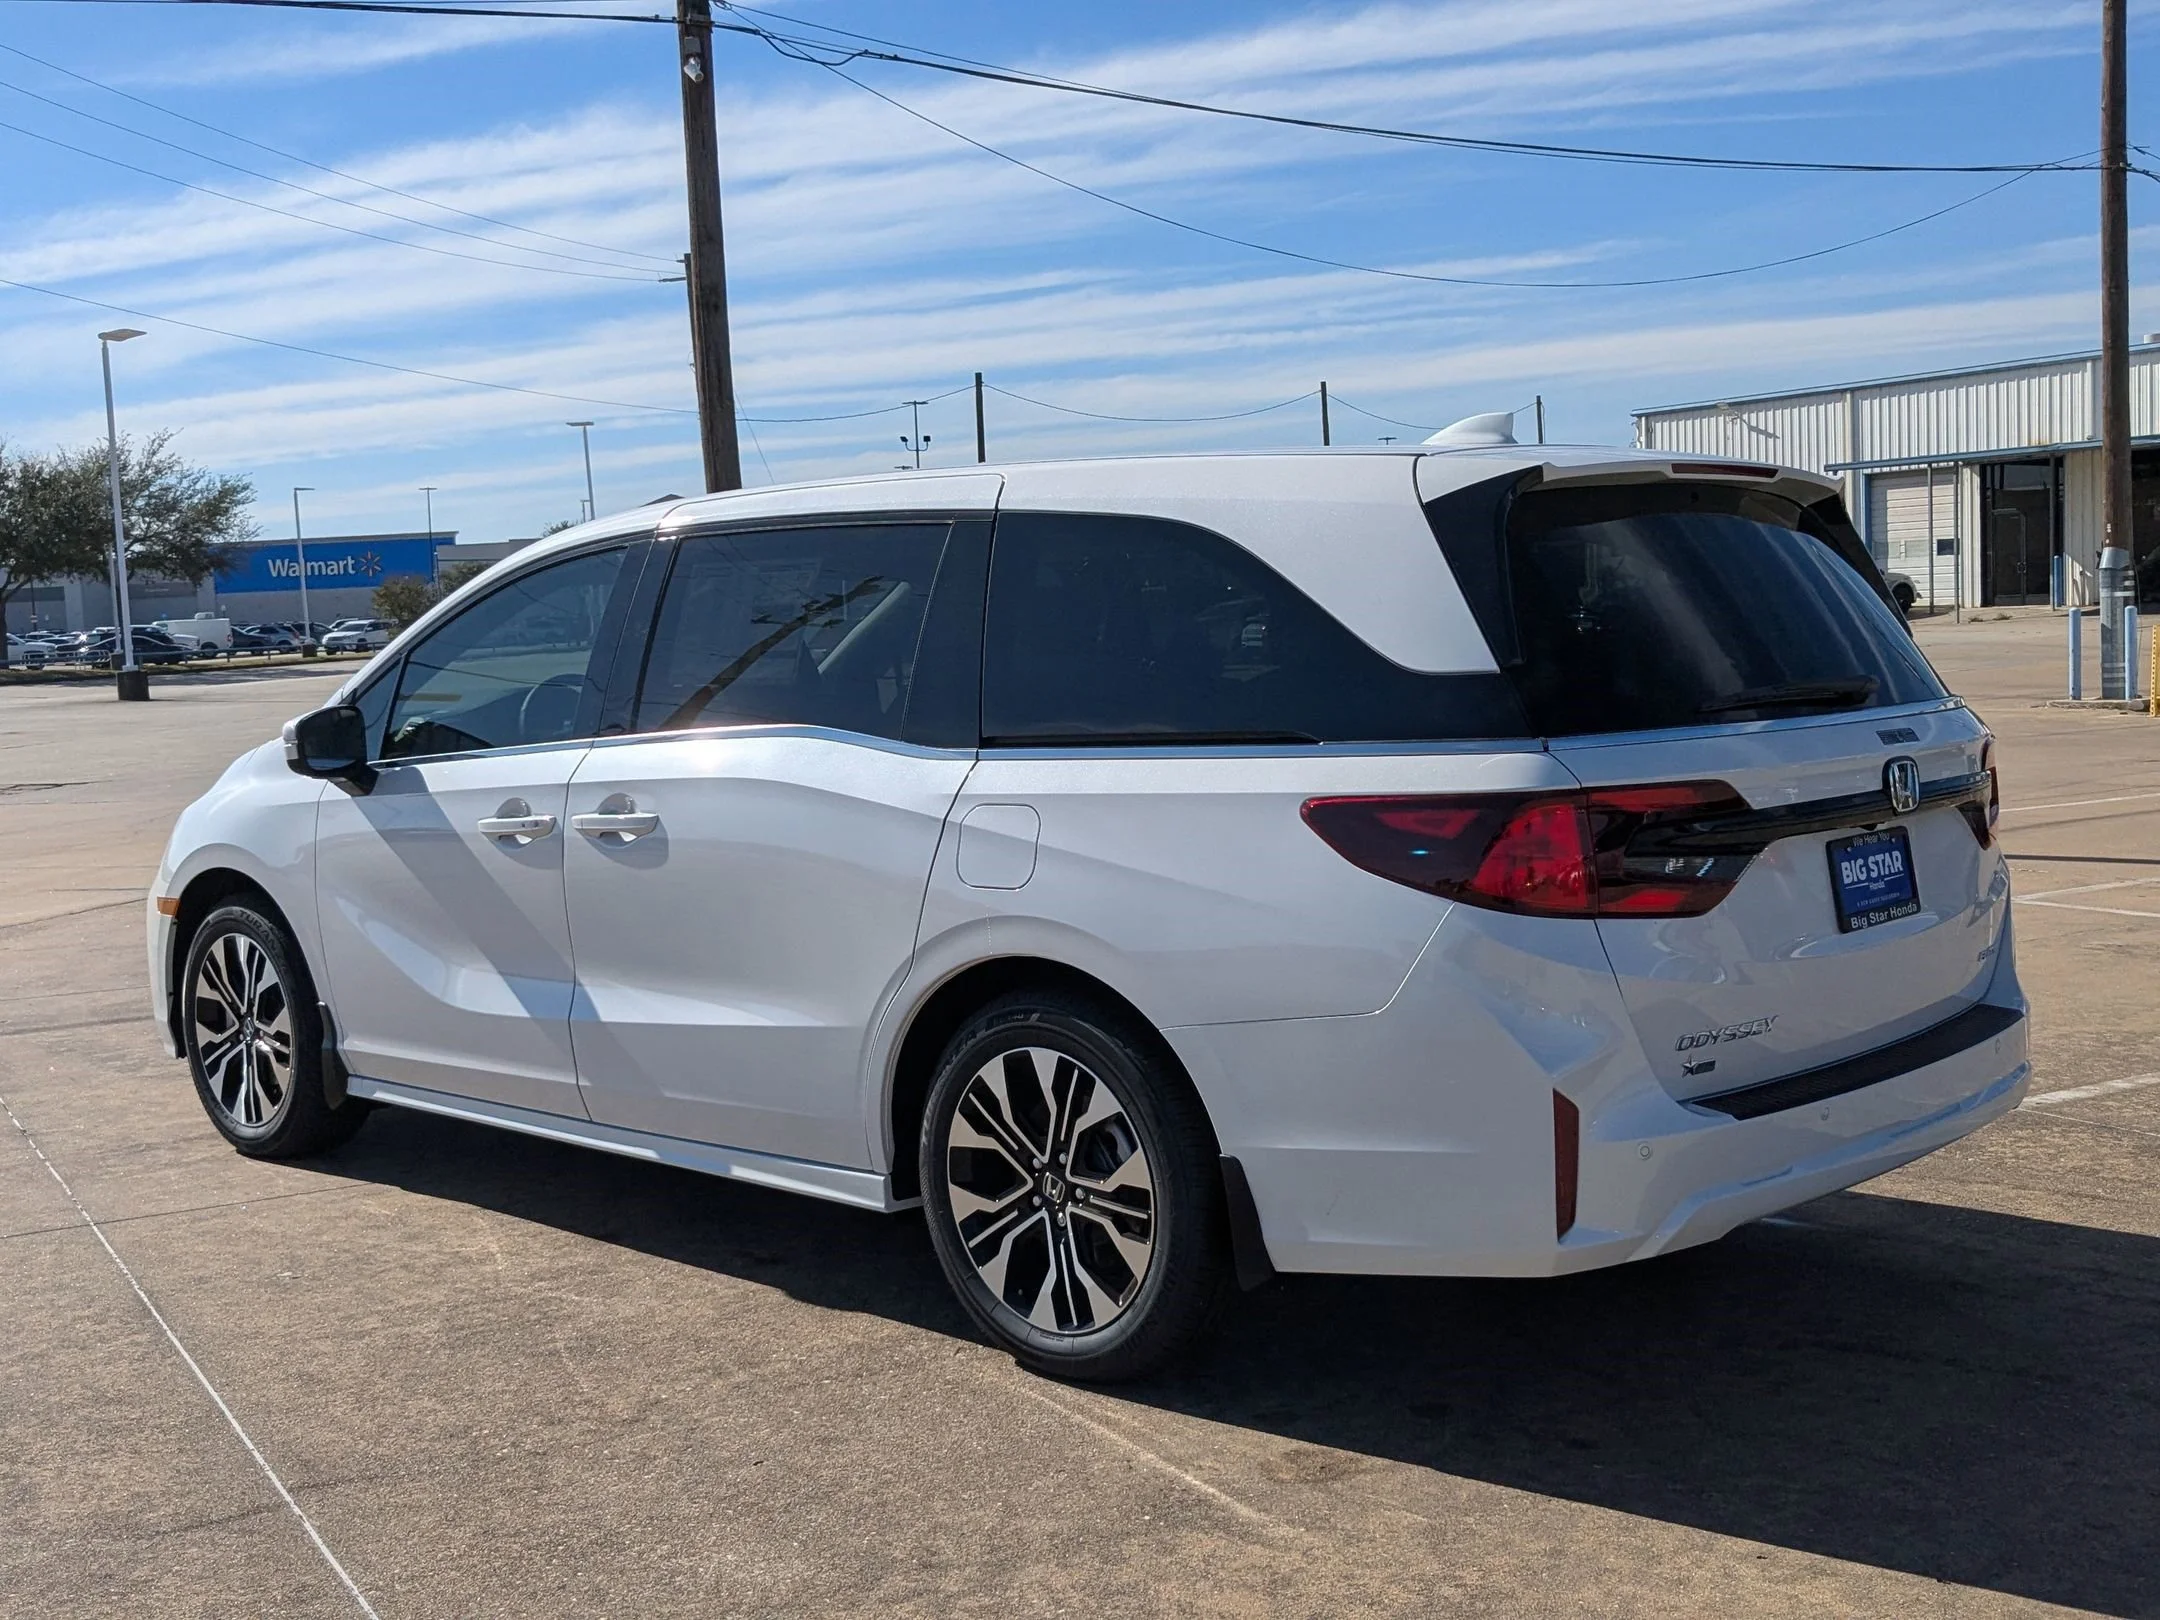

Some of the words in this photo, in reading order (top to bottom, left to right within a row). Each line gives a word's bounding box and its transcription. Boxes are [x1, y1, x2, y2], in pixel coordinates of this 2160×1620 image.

[1853, 838, 1864, 847] We
[1878, 832, 1890, 841] You
[1841, 859, 1867, 884] BIG
[1868, 851, 1903, 878] STAR
[1851, 916, 1867, 928] Big
[1869, 910, 1888, 923] Star
[1890, 902, 1917, 918] Honda
[1675, 1014, 1779, 1051] ODYSSEY
